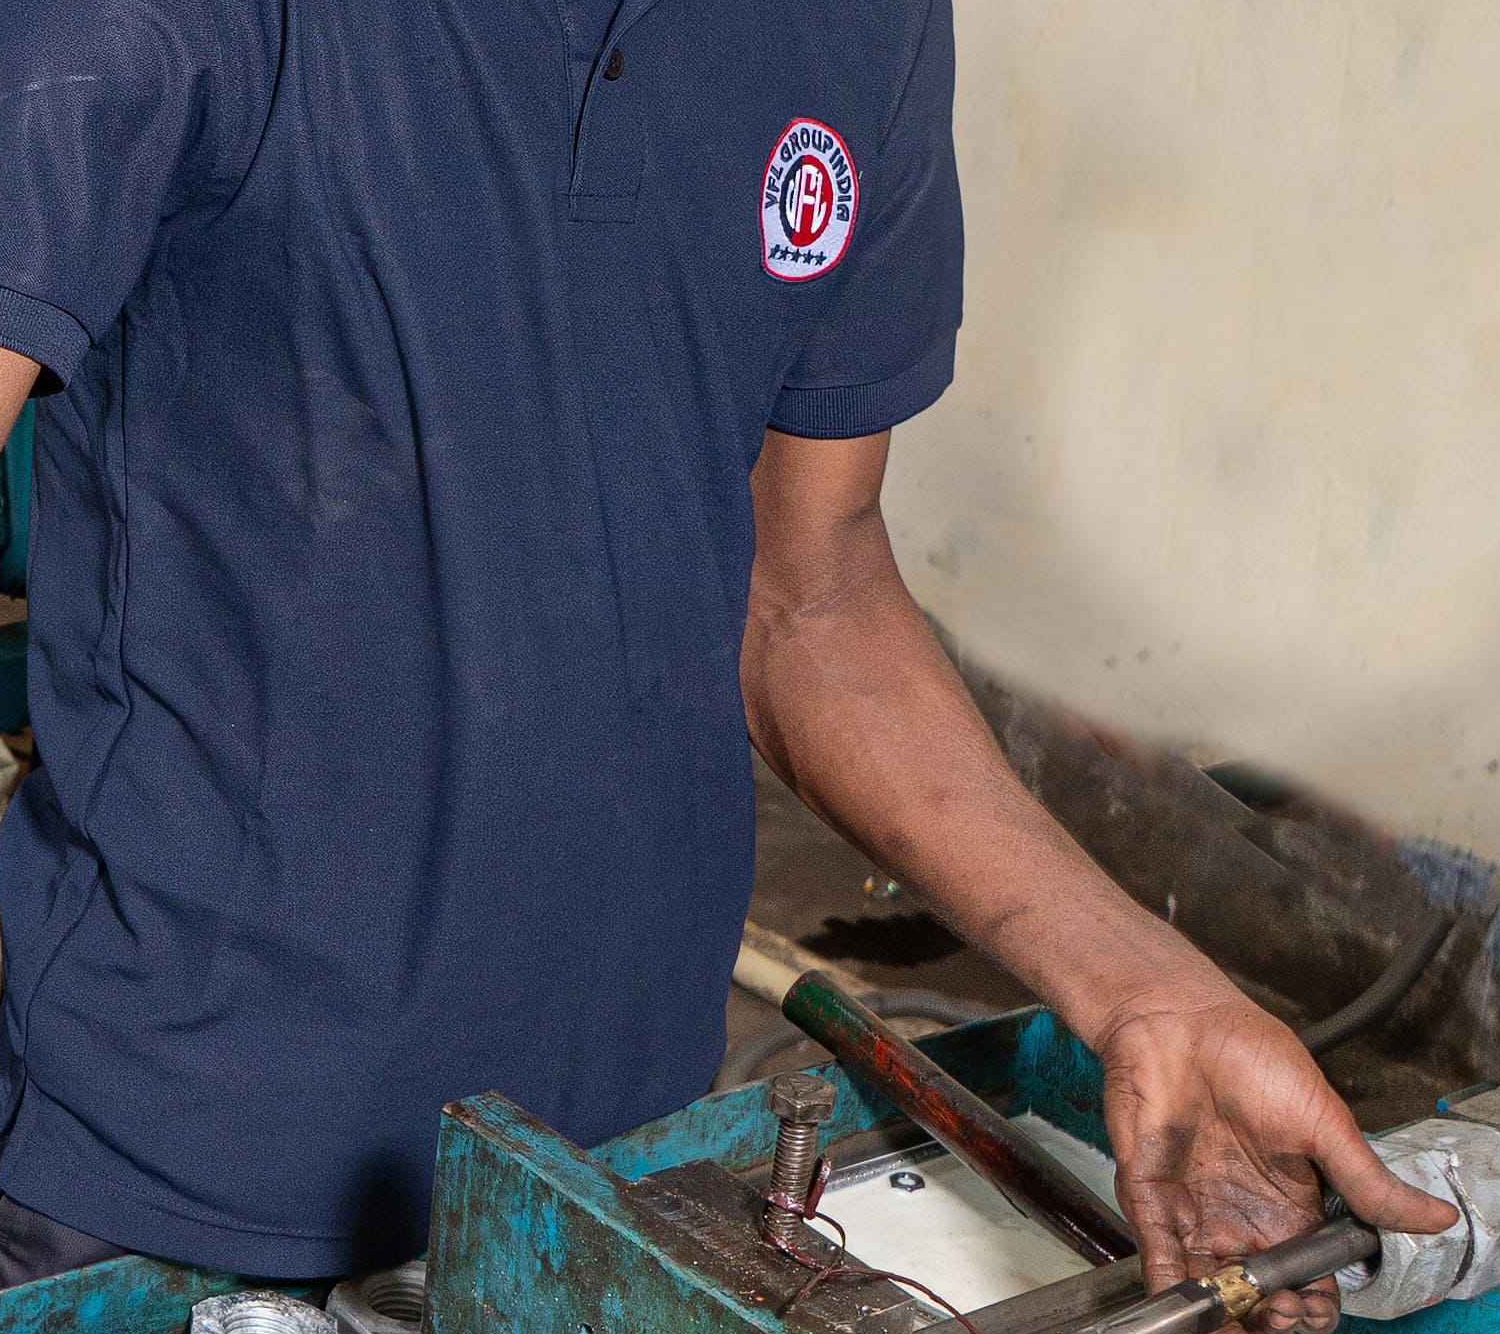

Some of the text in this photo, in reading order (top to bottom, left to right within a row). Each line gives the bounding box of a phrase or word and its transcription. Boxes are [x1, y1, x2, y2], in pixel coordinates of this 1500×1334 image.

[765, 127, 853, 222] VFL GROUP INDIA
